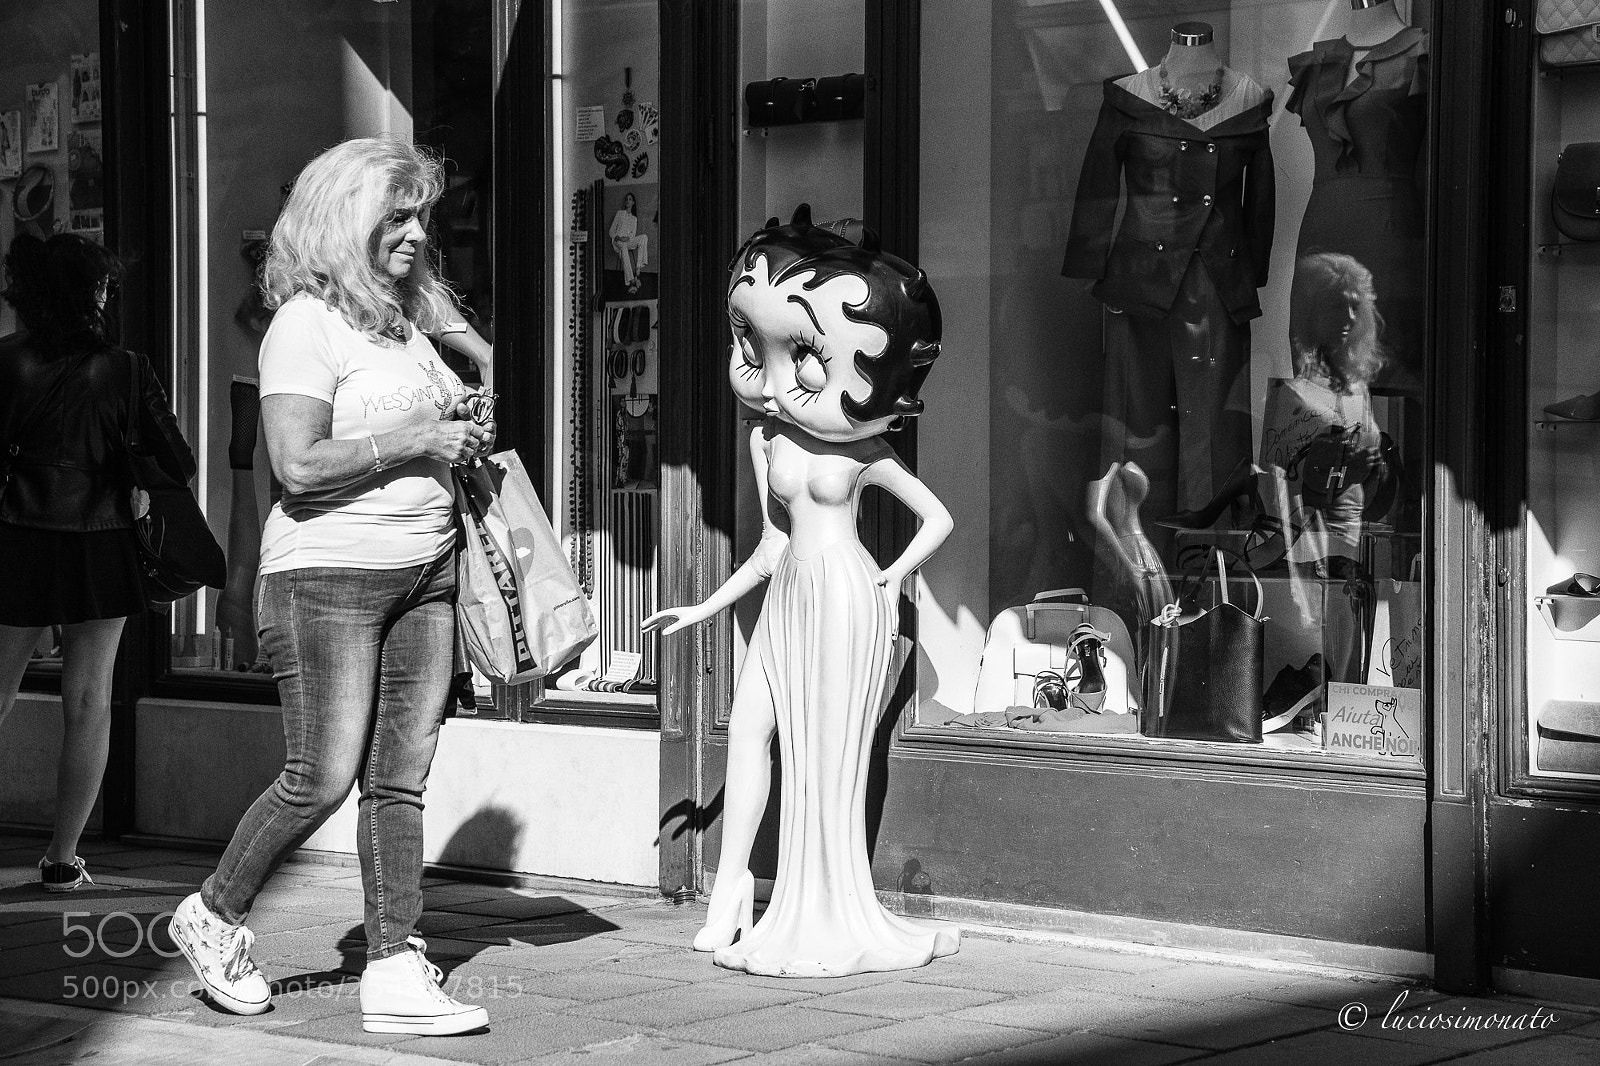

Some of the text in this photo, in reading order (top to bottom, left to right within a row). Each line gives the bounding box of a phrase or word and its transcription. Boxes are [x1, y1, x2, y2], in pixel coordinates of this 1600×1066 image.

[1332, 685, 1350, 694] CHI
[1331, 705, 1381, 726] Aiuta
[1330, 732, 1382, 751] ANCHE
